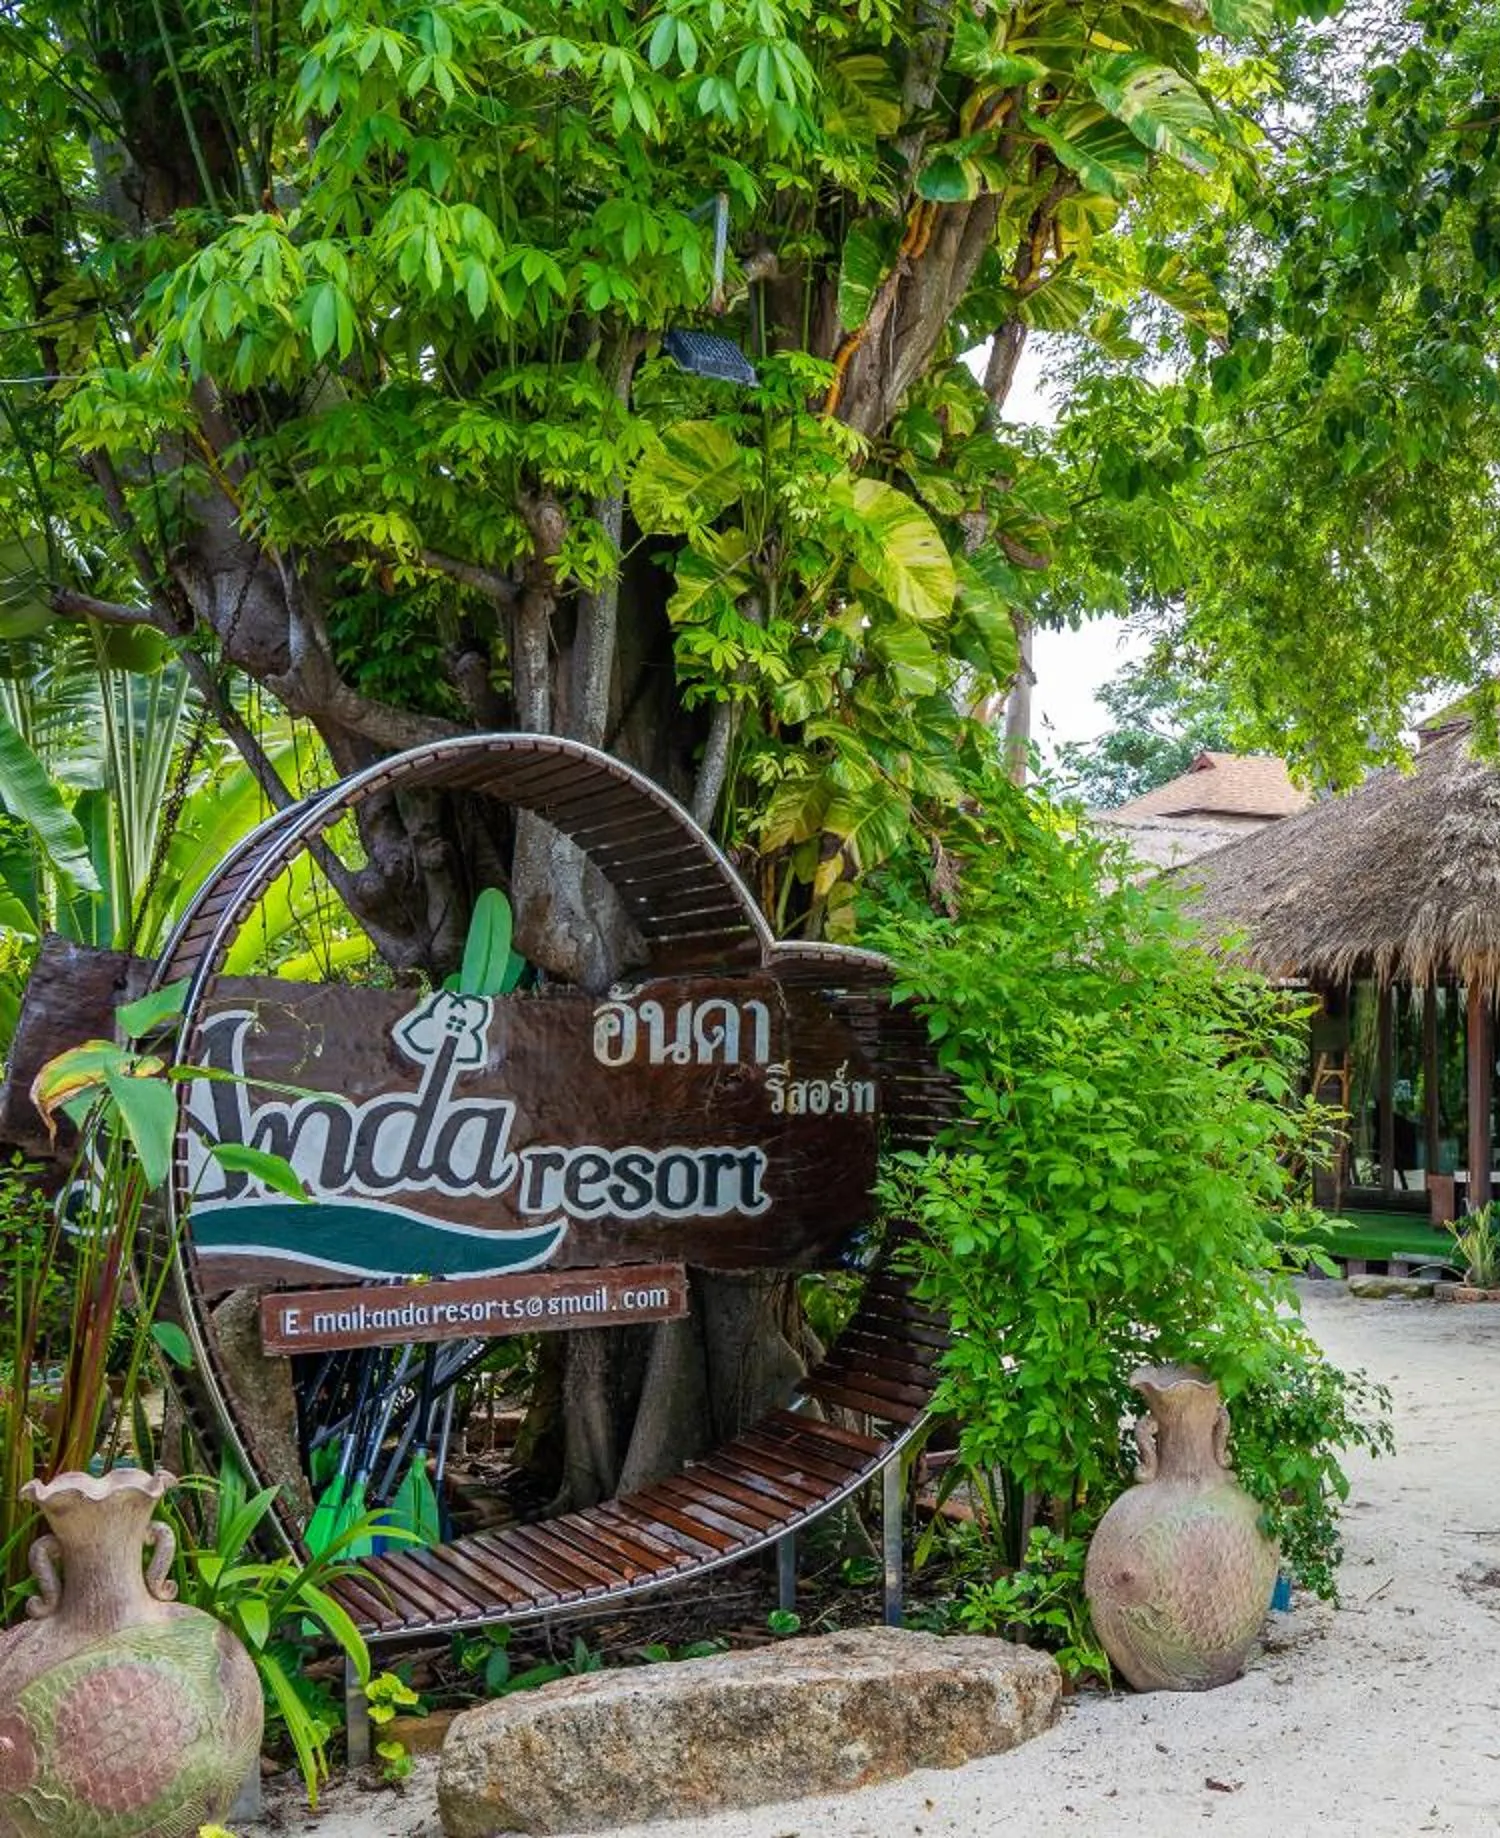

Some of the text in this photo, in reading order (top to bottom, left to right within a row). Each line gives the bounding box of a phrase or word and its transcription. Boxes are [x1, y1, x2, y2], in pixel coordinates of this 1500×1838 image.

[593, 983, 769, 1067] อันดา
[765, 1060, 876, 1115] รีสอร์ท
[521, 1147, 771, 1217] resort
